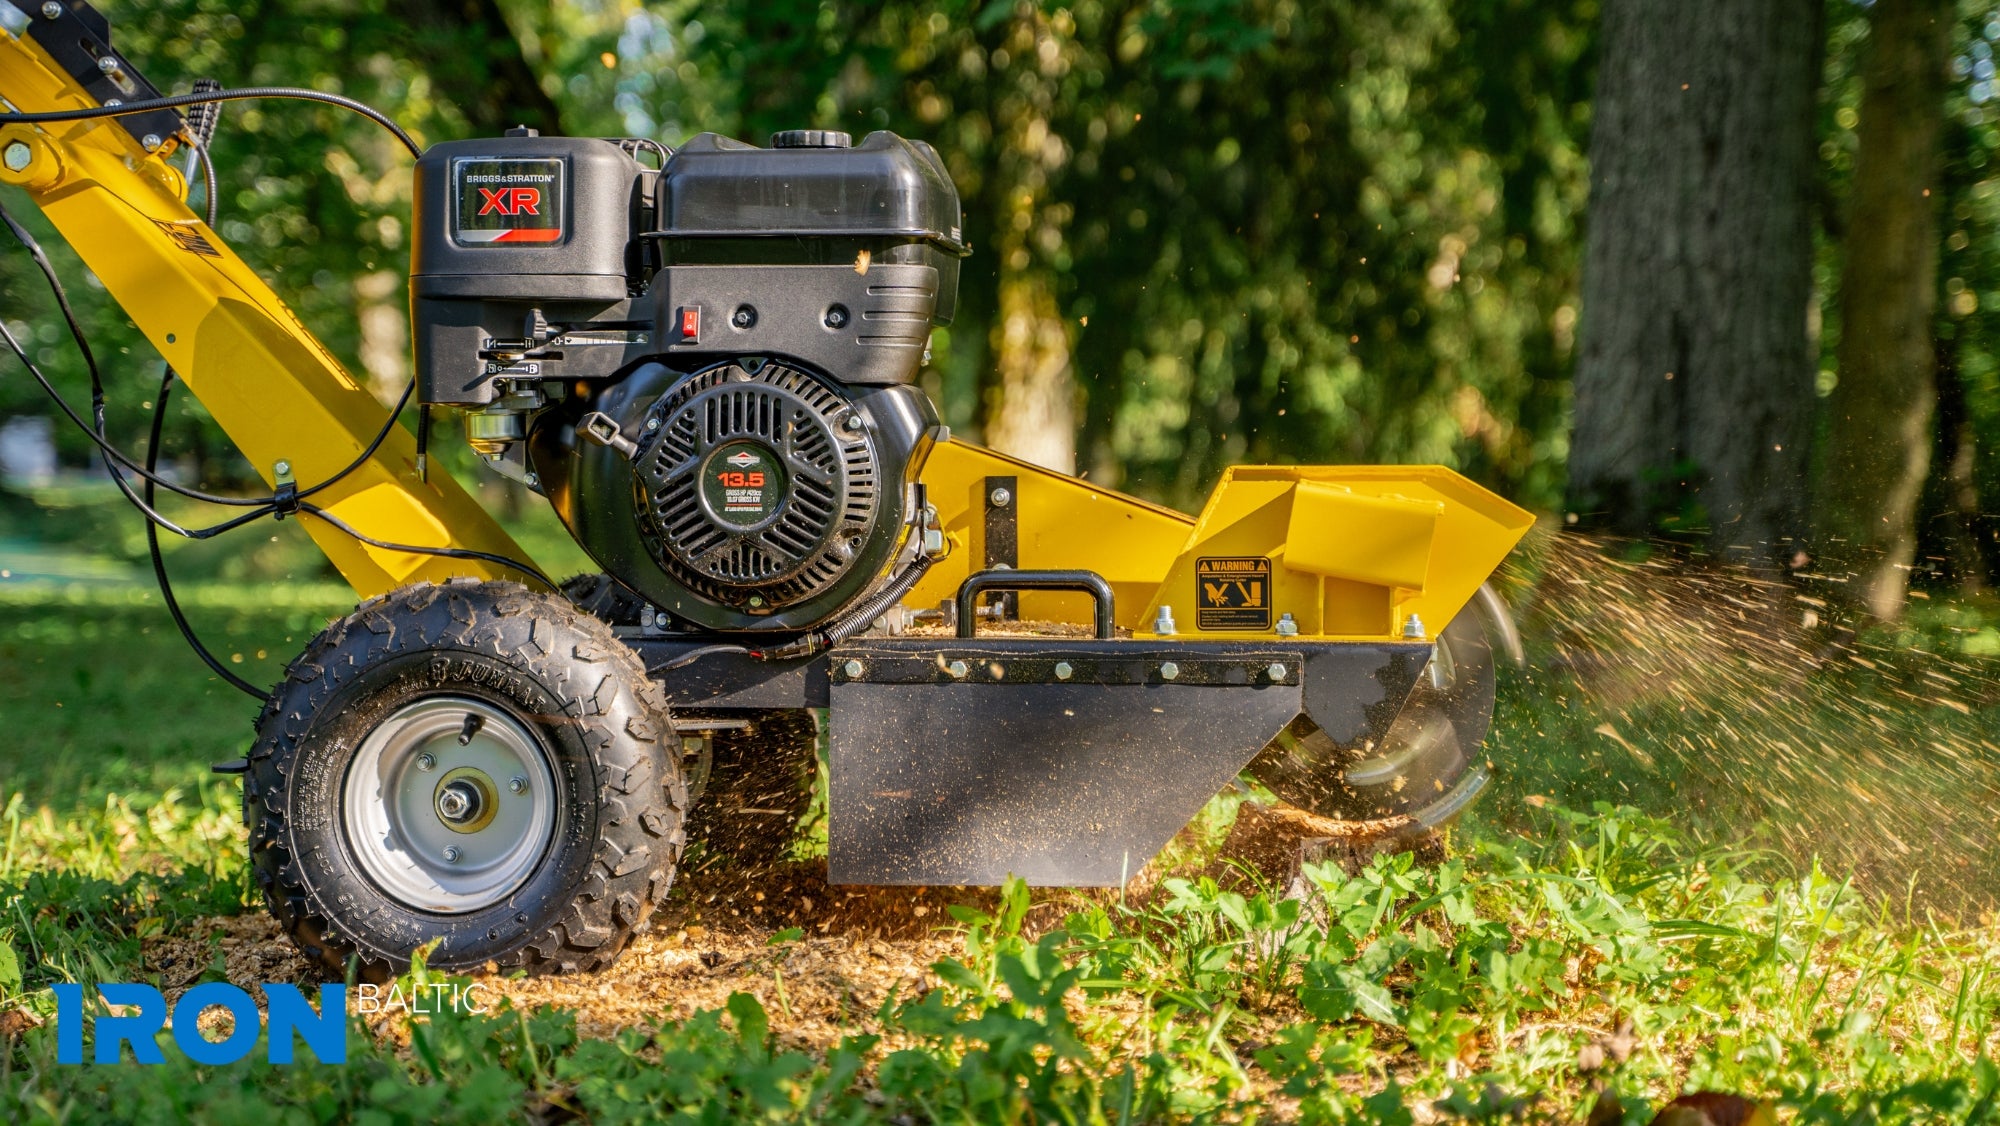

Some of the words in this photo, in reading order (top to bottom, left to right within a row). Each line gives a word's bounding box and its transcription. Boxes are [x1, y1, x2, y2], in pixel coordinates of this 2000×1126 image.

[478, 187, 540, 215] XR
[717, 472, 765, 487] 13.5
[1211, 560, 1255, 571] WARNING
